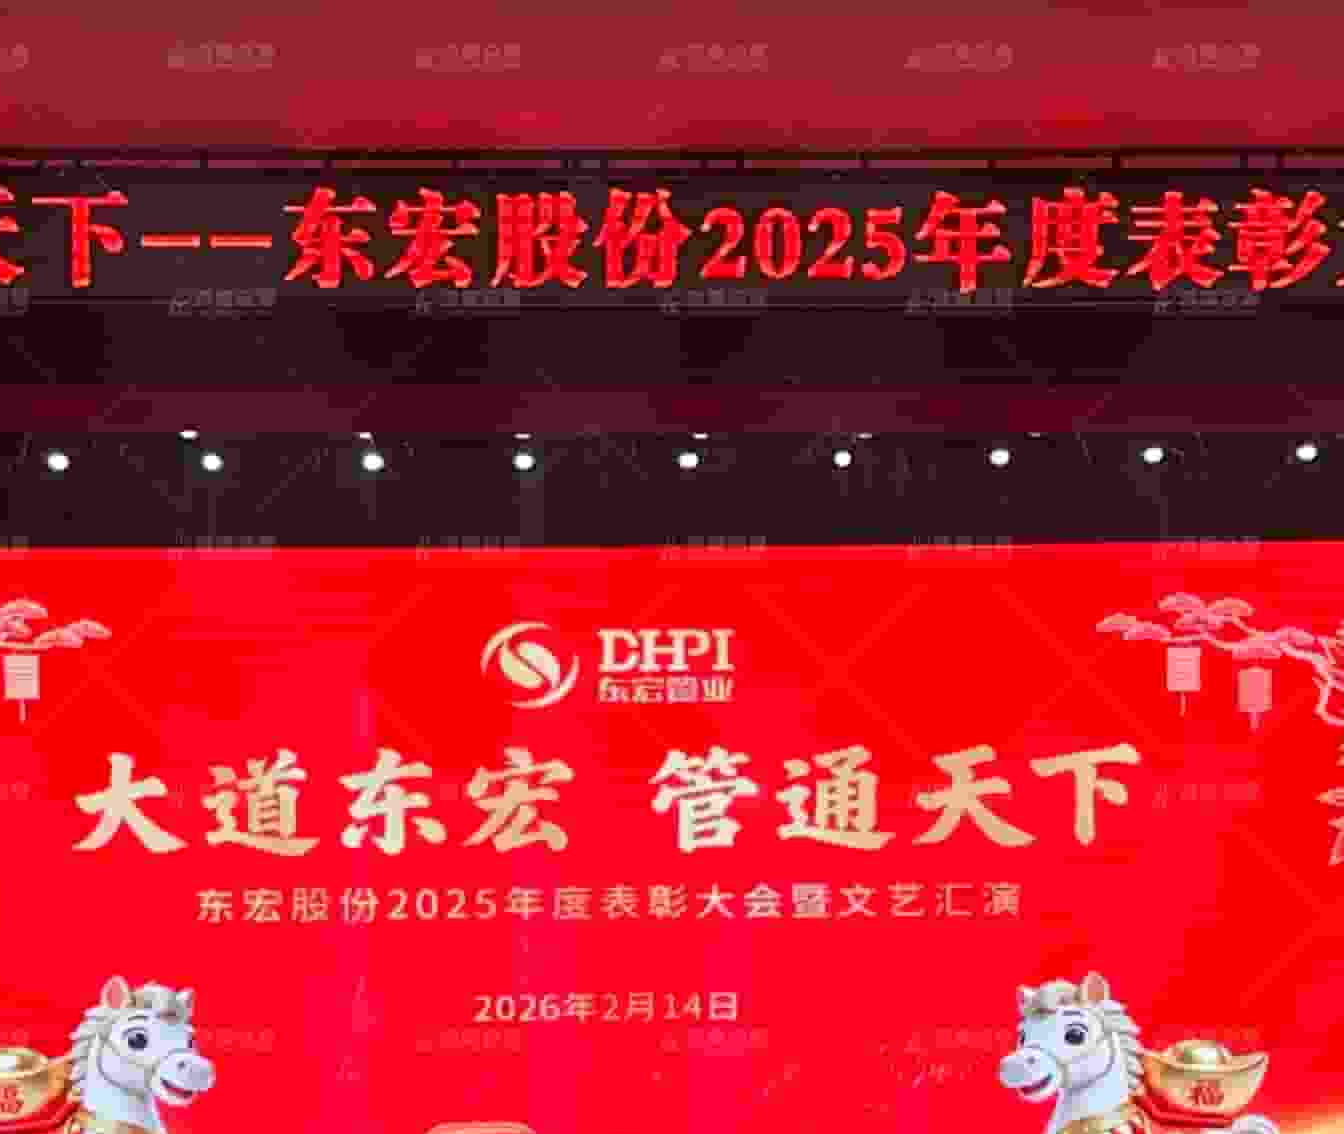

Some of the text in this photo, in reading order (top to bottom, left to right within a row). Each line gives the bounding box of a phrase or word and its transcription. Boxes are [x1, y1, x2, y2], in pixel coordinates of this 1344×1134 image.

[597, 627, 735, 672] DHPI
[72, 743, 1142, 857] 大道东宏 管通天下
[195, 881, 1022, 925] 东宏股份2025年度表彰大会暨文艺汇演
[474, 991, 740, 1024] 2026年2月14日
